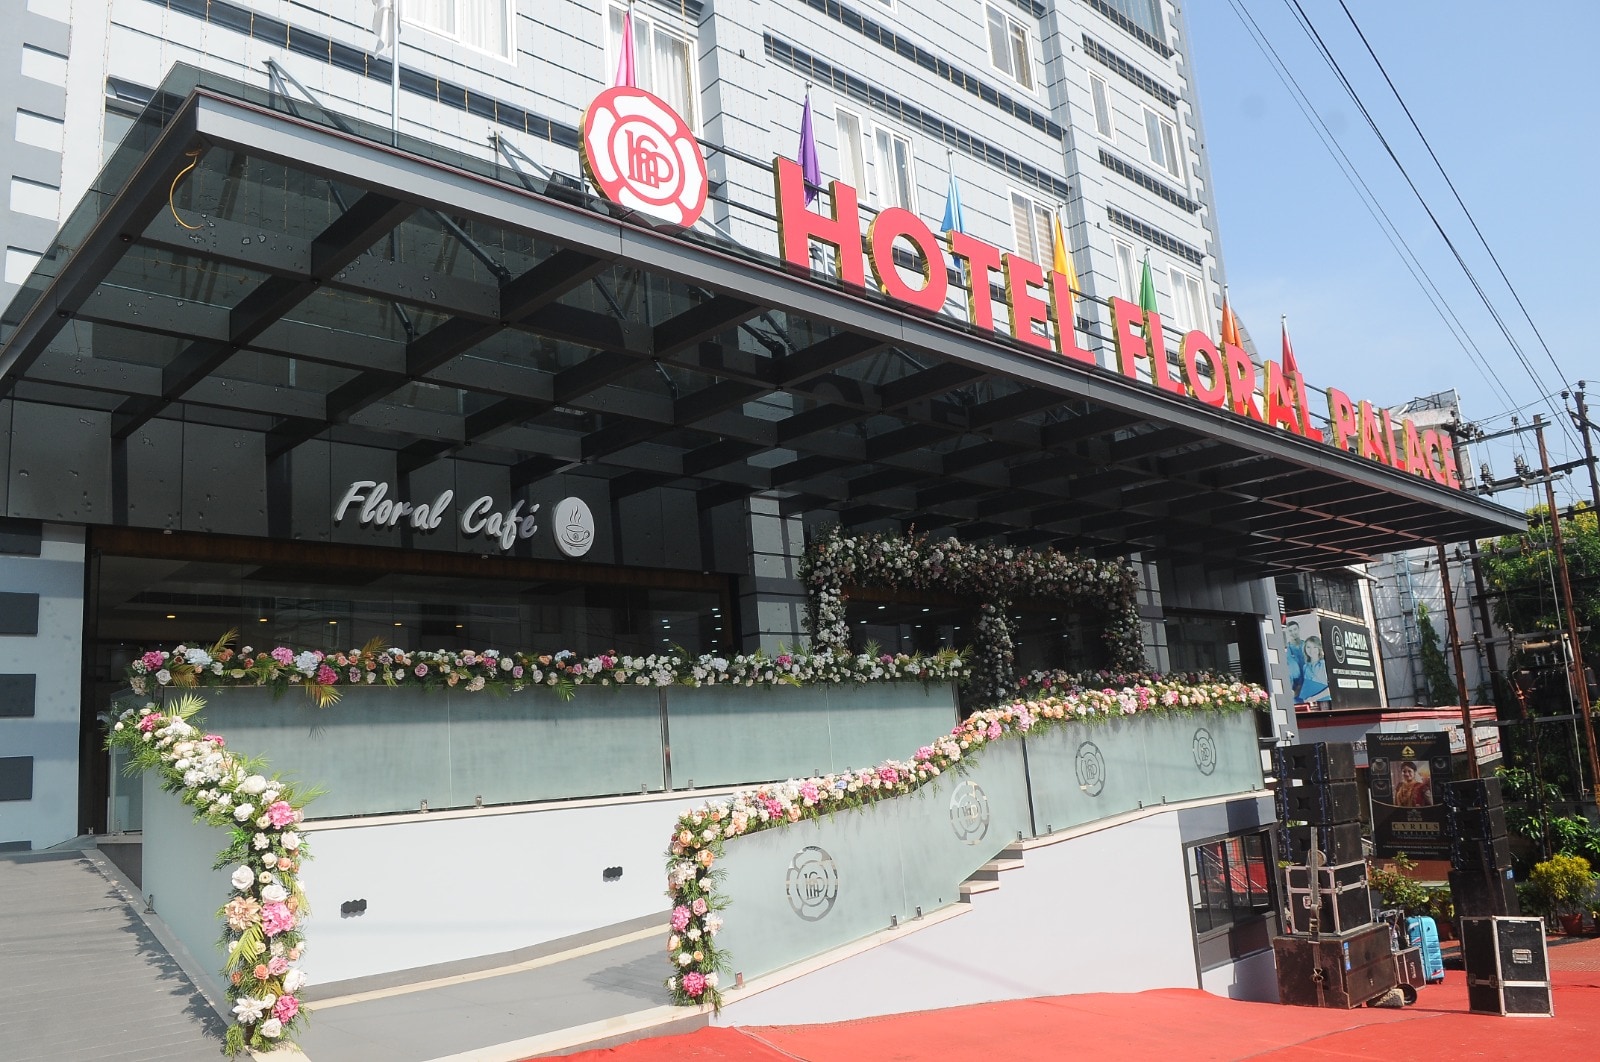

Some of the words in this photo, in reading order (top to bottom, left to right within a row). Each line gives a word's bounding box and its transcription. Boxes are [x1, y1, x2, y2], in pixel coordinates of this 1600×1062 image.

[773, 156, 1097, 366] HOTEL
[1109, 296, 1324, 444] FLORAL
[1327, 387, 1462, 491] PALACE
[334, 480, 454, 531] Floral
[461, 495, 540, 550] Café
[1392, 822, 1440, 830] CYRILS
